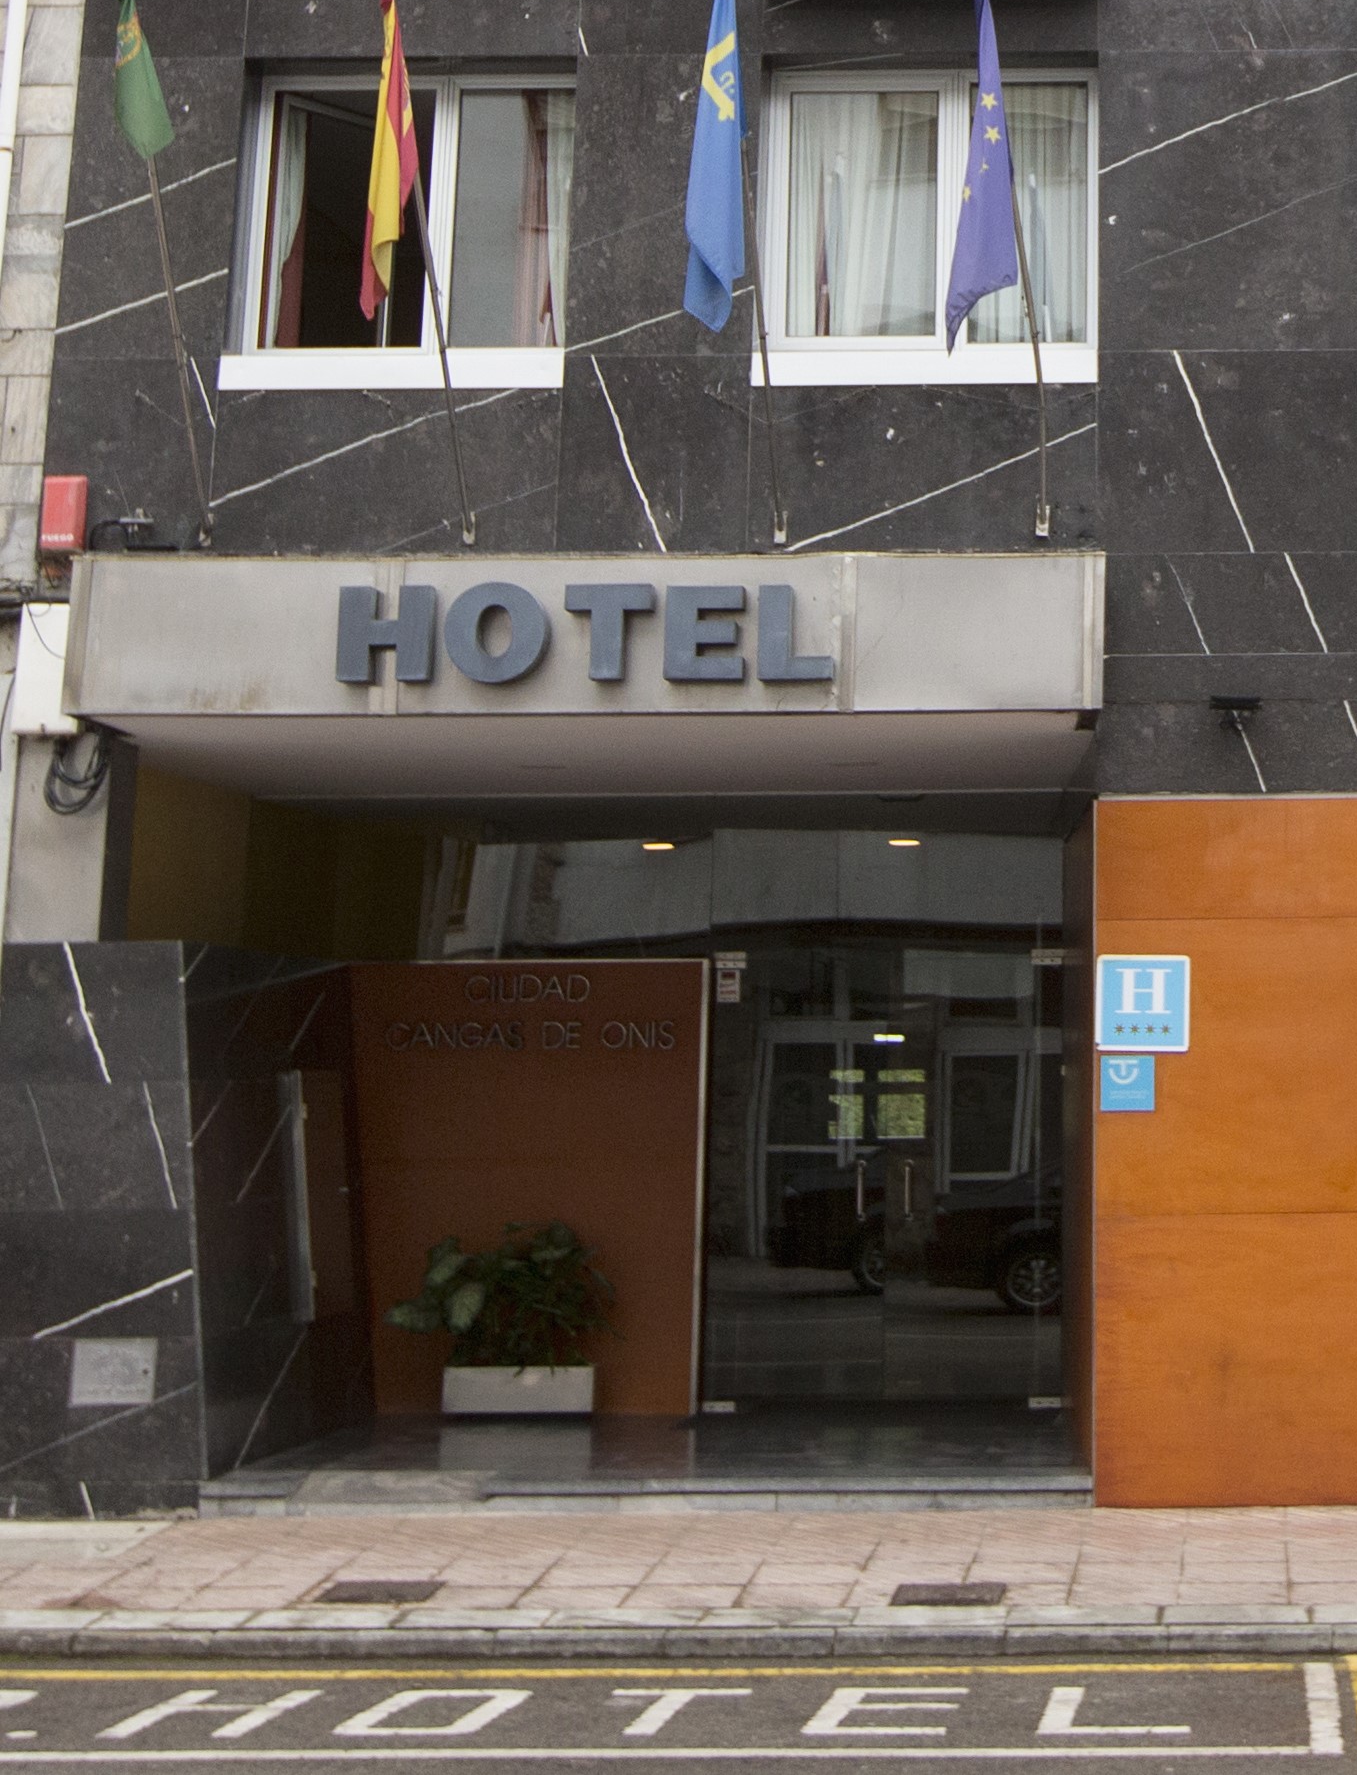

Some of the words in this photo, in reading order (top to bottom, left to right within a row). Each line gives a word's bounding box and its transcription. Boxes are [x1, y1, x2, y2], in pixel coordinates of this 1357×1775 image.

[335, 581, 836, 684] HOTEL
[463, 974, 591, 1004] CIUDAD
[1114, 967, 1173, 1015] H
[384, 1021, 524, 1051] CANGAS
[541, 1021, 583, 1049] DE
[600, 1020, 676, 1050] ONIS
[96, 1686, 1191, 1738] HOTEL
